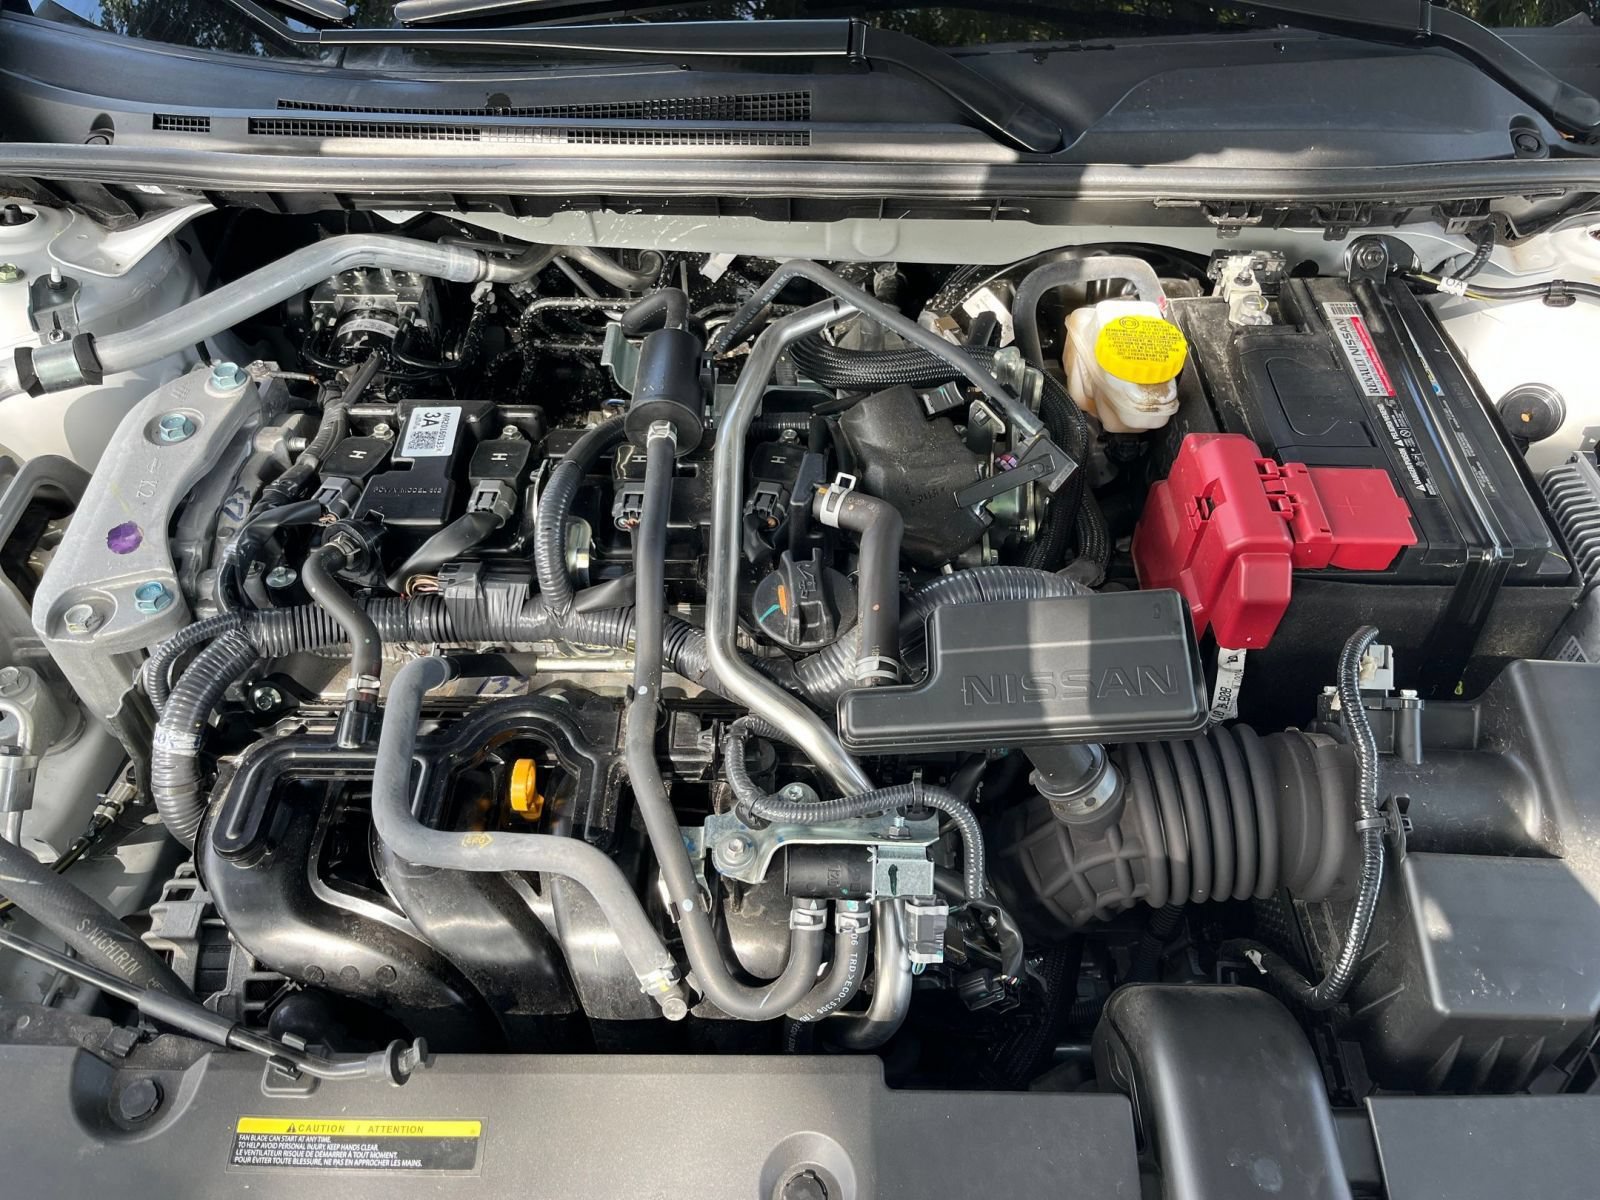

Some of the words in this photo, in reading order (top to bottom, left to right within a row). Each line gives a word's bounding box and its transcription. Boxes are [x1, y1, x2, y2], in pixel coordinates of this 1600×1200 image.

[1336, 318, 1360, 356] NISSAN
[421, 412, 441, 428] 3A
[961, 665, 1179, 707] NISSAN
[298, 1124, 345, 1133] CAUTION
[367, 1125, 425, 1134] ATTENTION
[244, 1149, 282, 1157] VENTILATEUR
[283, 1150, 305, 1158] RISQUE
[353, 1151, 370, 1159] TOUT
[323, 1158, 332, 1166] NE
[344, 1159, 353, 1167] EN
[353, 1159, 390, 1167] APPROCHER
[390, 1159, 400, 1167] LES
